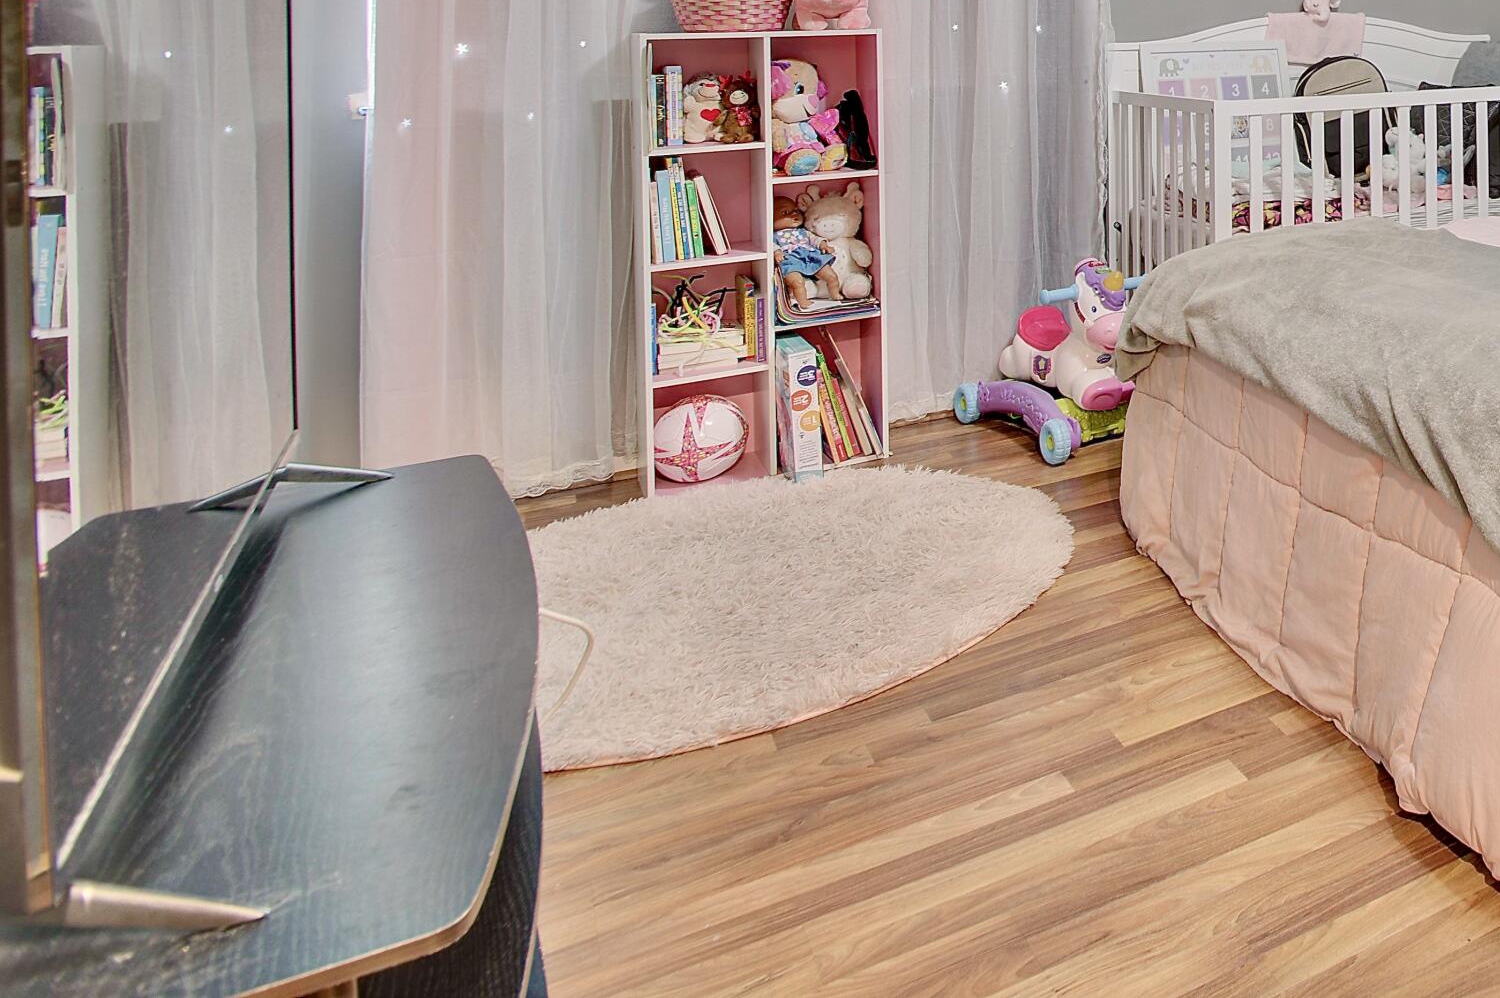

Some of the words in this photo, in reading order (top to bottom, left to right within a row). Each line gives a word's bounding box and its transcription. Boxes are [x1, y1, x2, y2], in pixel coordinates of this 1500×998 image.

[1200, 85, 1209, 99] 2
[1231, 83, 1241, 97] 3
[1261, 82, 1270, 95] 4
[1266, 118, 1274, 131] 8
